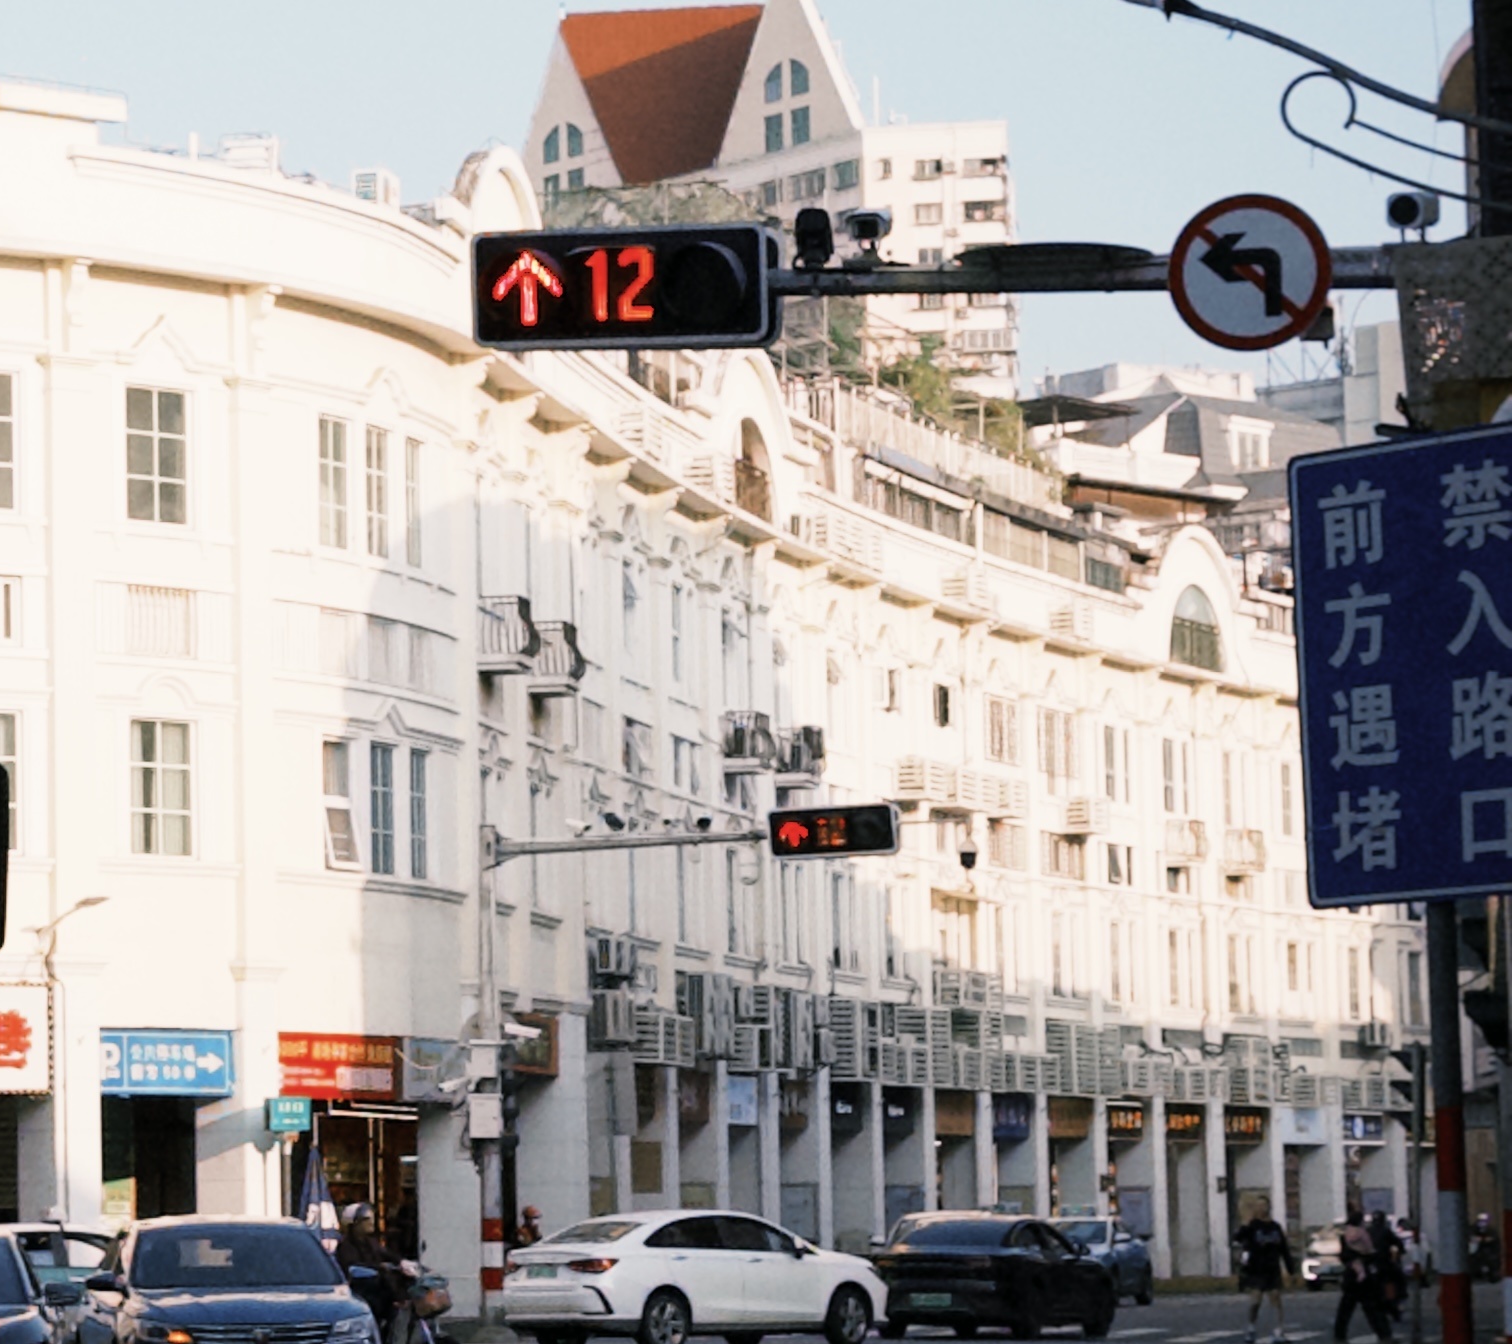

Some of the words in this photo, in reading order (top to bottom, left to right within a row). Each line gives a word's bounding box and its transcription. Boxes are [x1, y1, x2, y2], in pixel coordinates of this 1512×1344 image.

[585, 246, 655, 322] 12
[1318, 479, 1401, 871] 前方遇堵
[1440, 459, 1512, 863] 禁入路口
